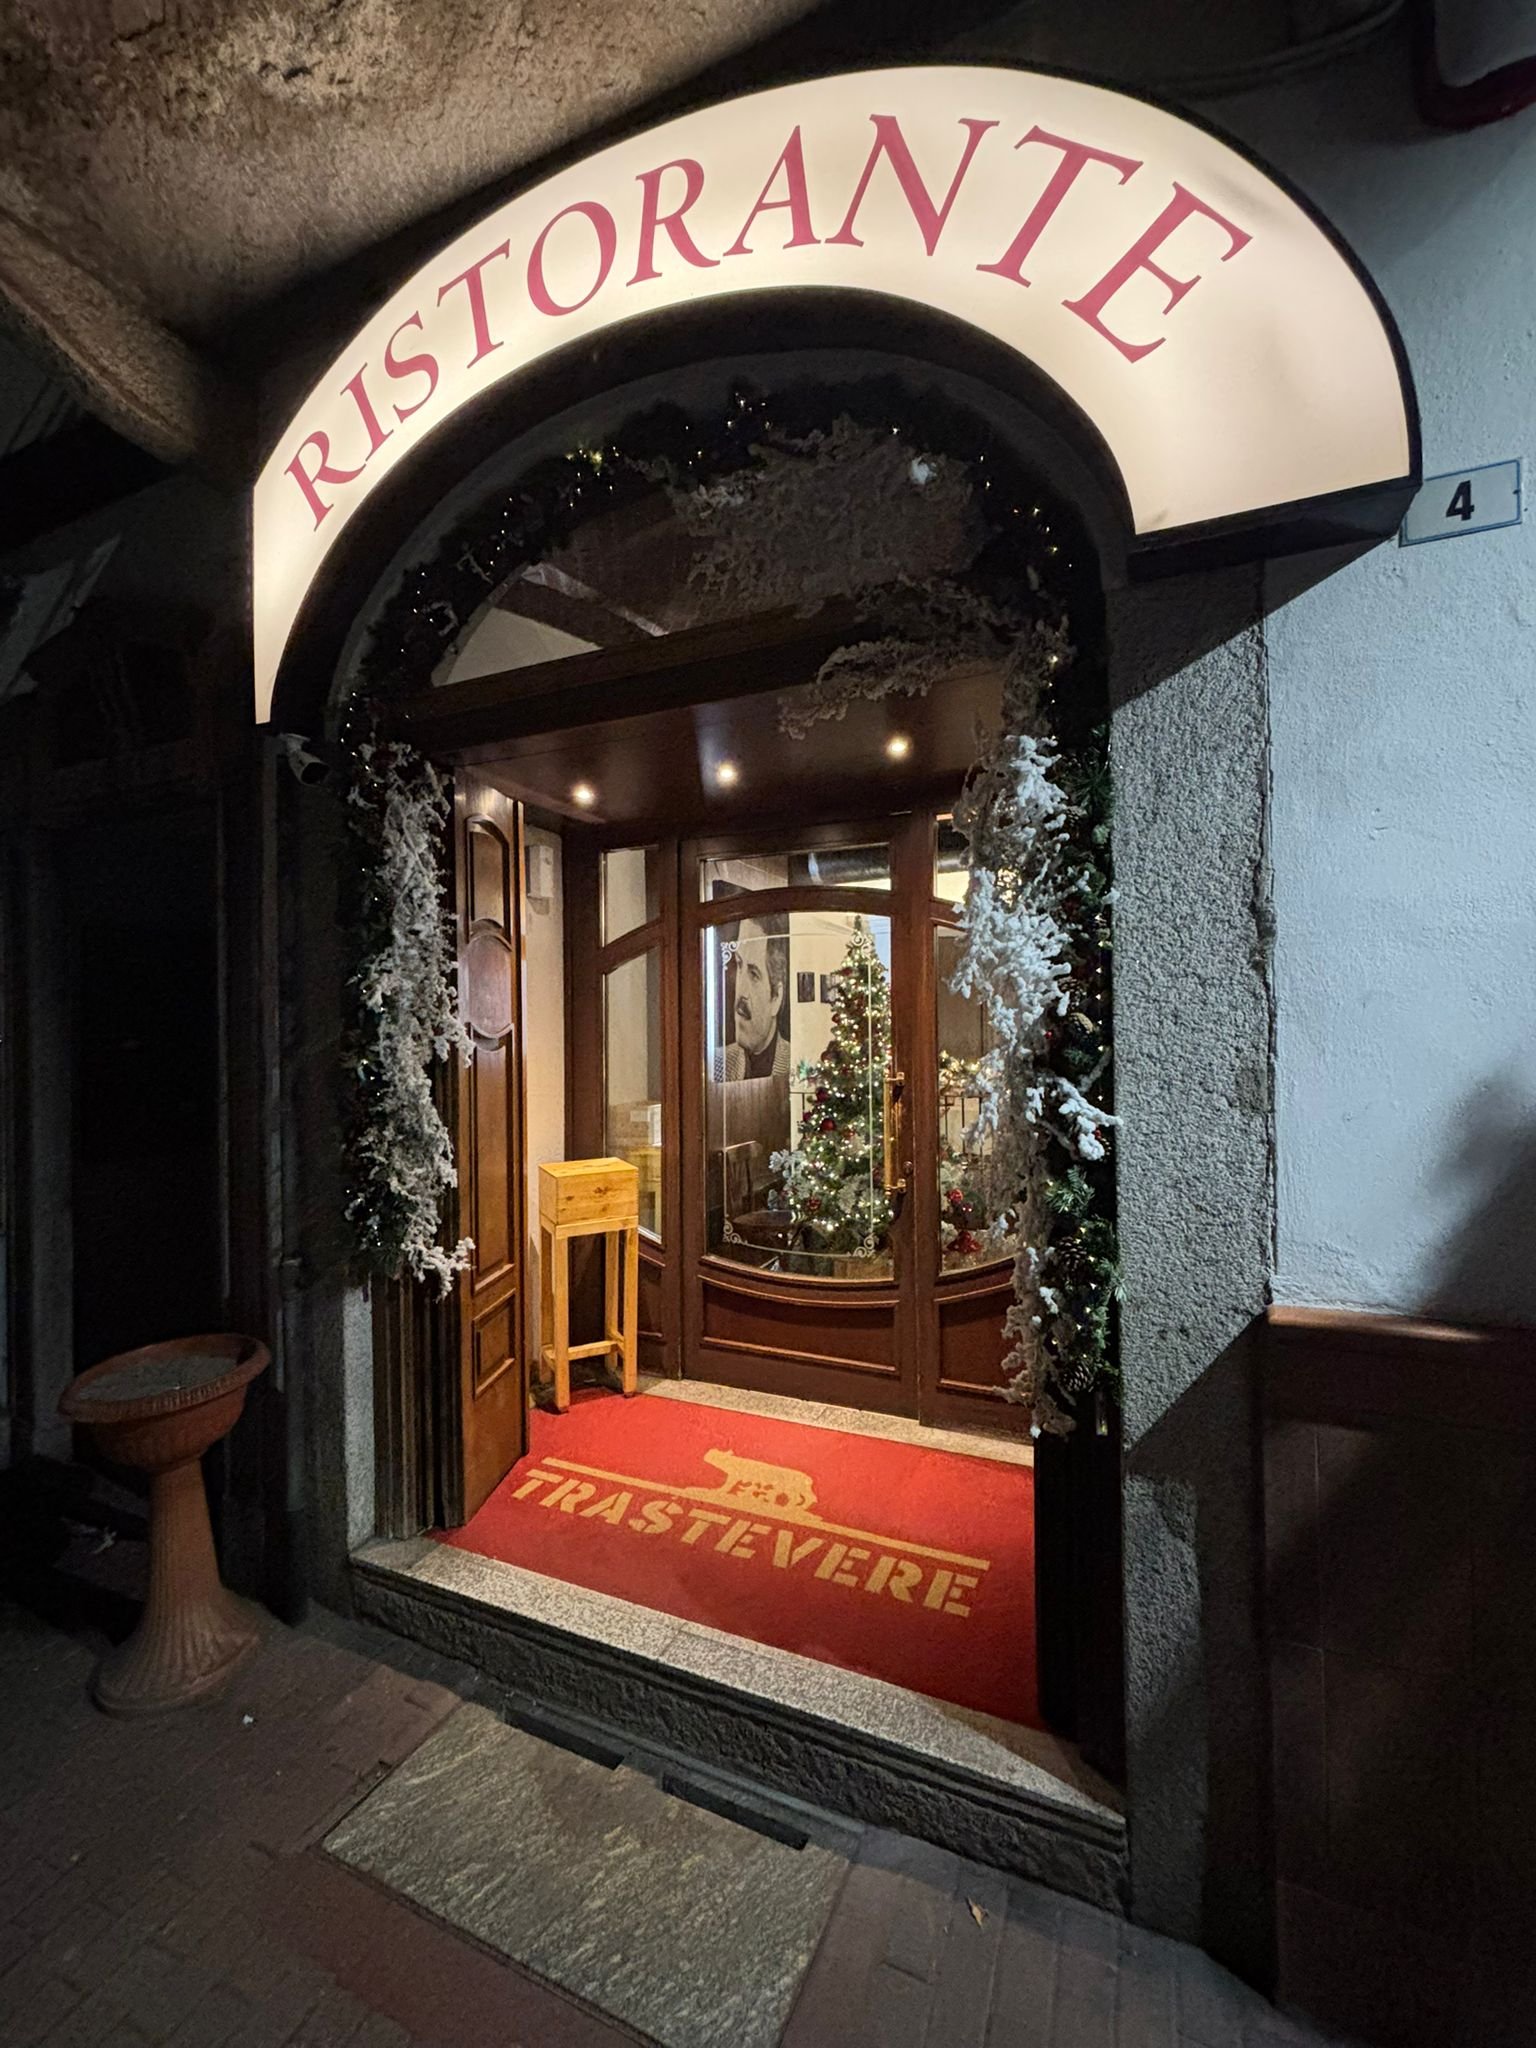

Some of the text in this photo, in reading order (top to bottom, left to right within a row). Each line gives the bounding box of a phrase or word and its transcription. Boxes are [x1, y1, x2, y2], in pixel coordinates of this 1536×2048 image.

[284, 115, 1252, 530] RISTORANTE
[1445, 480, 1475, 521] 4
[512, 1469, 980, 1617] TRASTEVERE
